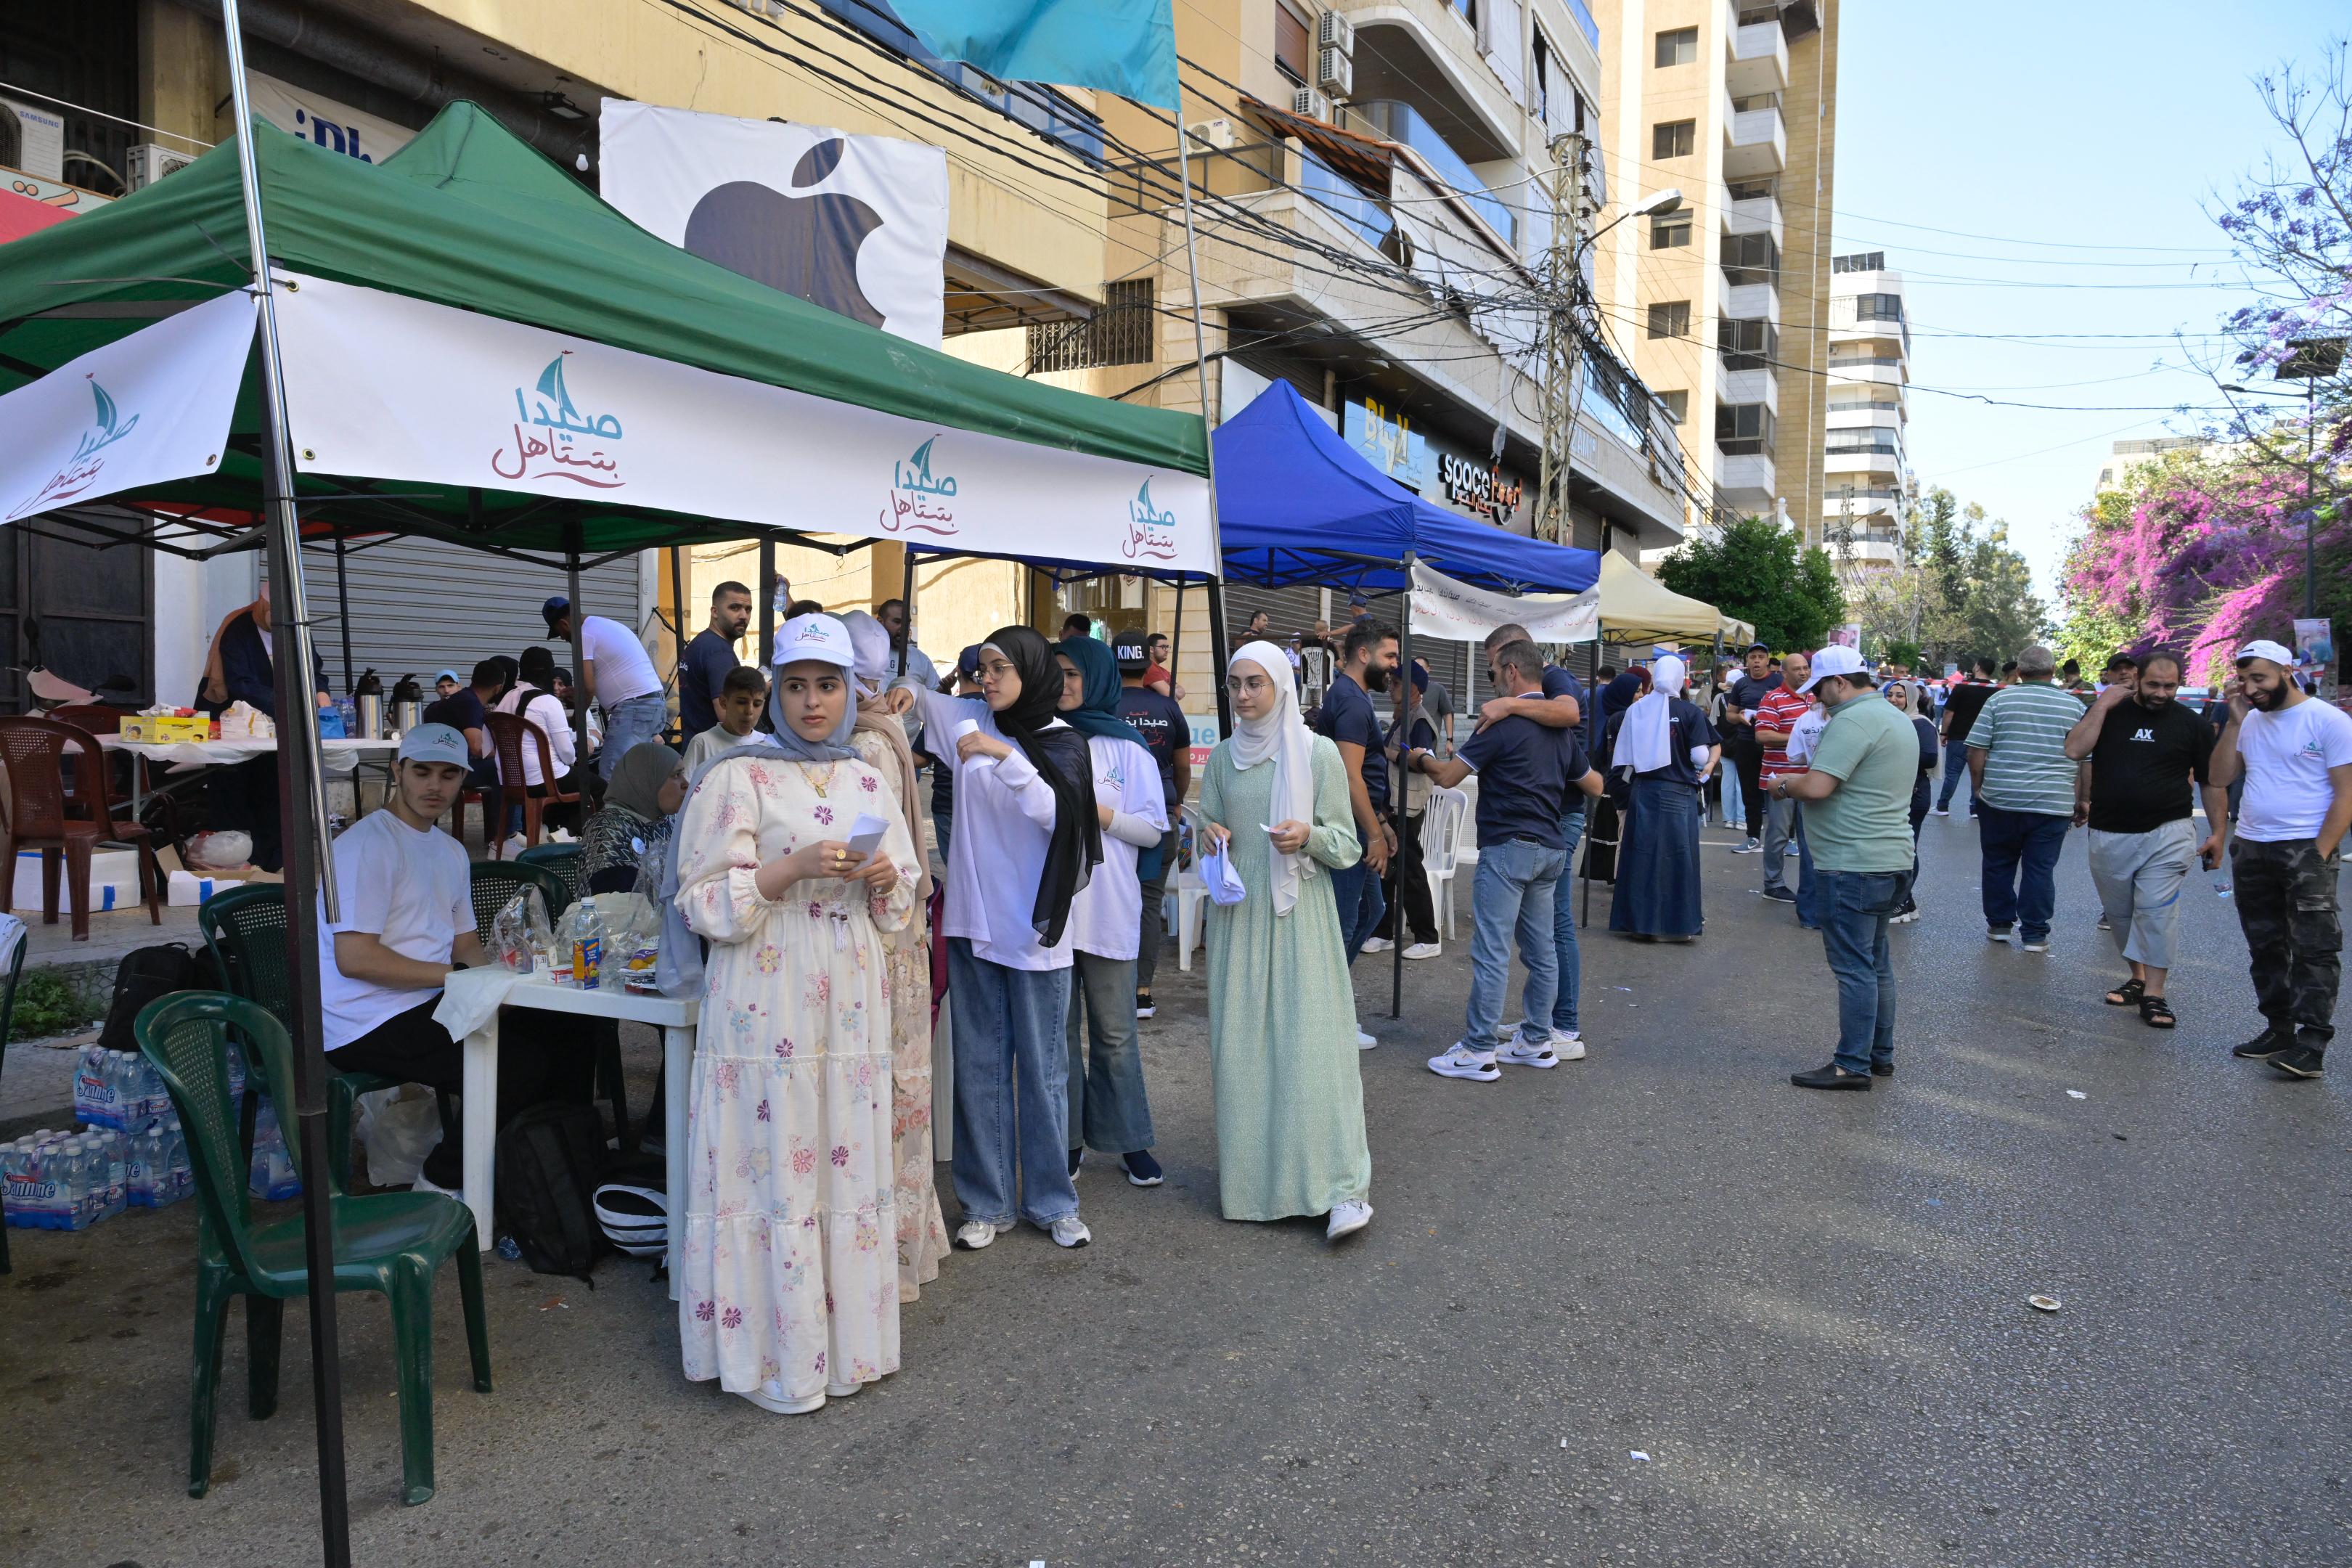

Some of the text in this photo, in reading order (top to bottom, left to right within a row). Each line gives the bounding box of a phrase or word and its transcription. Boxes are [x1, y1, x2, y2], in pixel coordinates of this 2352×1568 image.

[20, 110, 60, 128] SAMSUNG
[515, 387, 623, 442] صيدا
[69, 413, 140, 465] صيدا
[491, 423, 618, 480] بتستاهل
[895, 460, 957, 501] صيدا
[1445, 454, 1490, 499] space
[880, 489, 955, 532] بتستاهل
[1130, 499, 1175, 531] صيدا
[1122, 523, 1175, 558] بتستاهل
[1117, 645, 1145, 659] KING.
[1140, 717, 1168, 727] صيدا
[2134, 728, 2153, 740] AX
